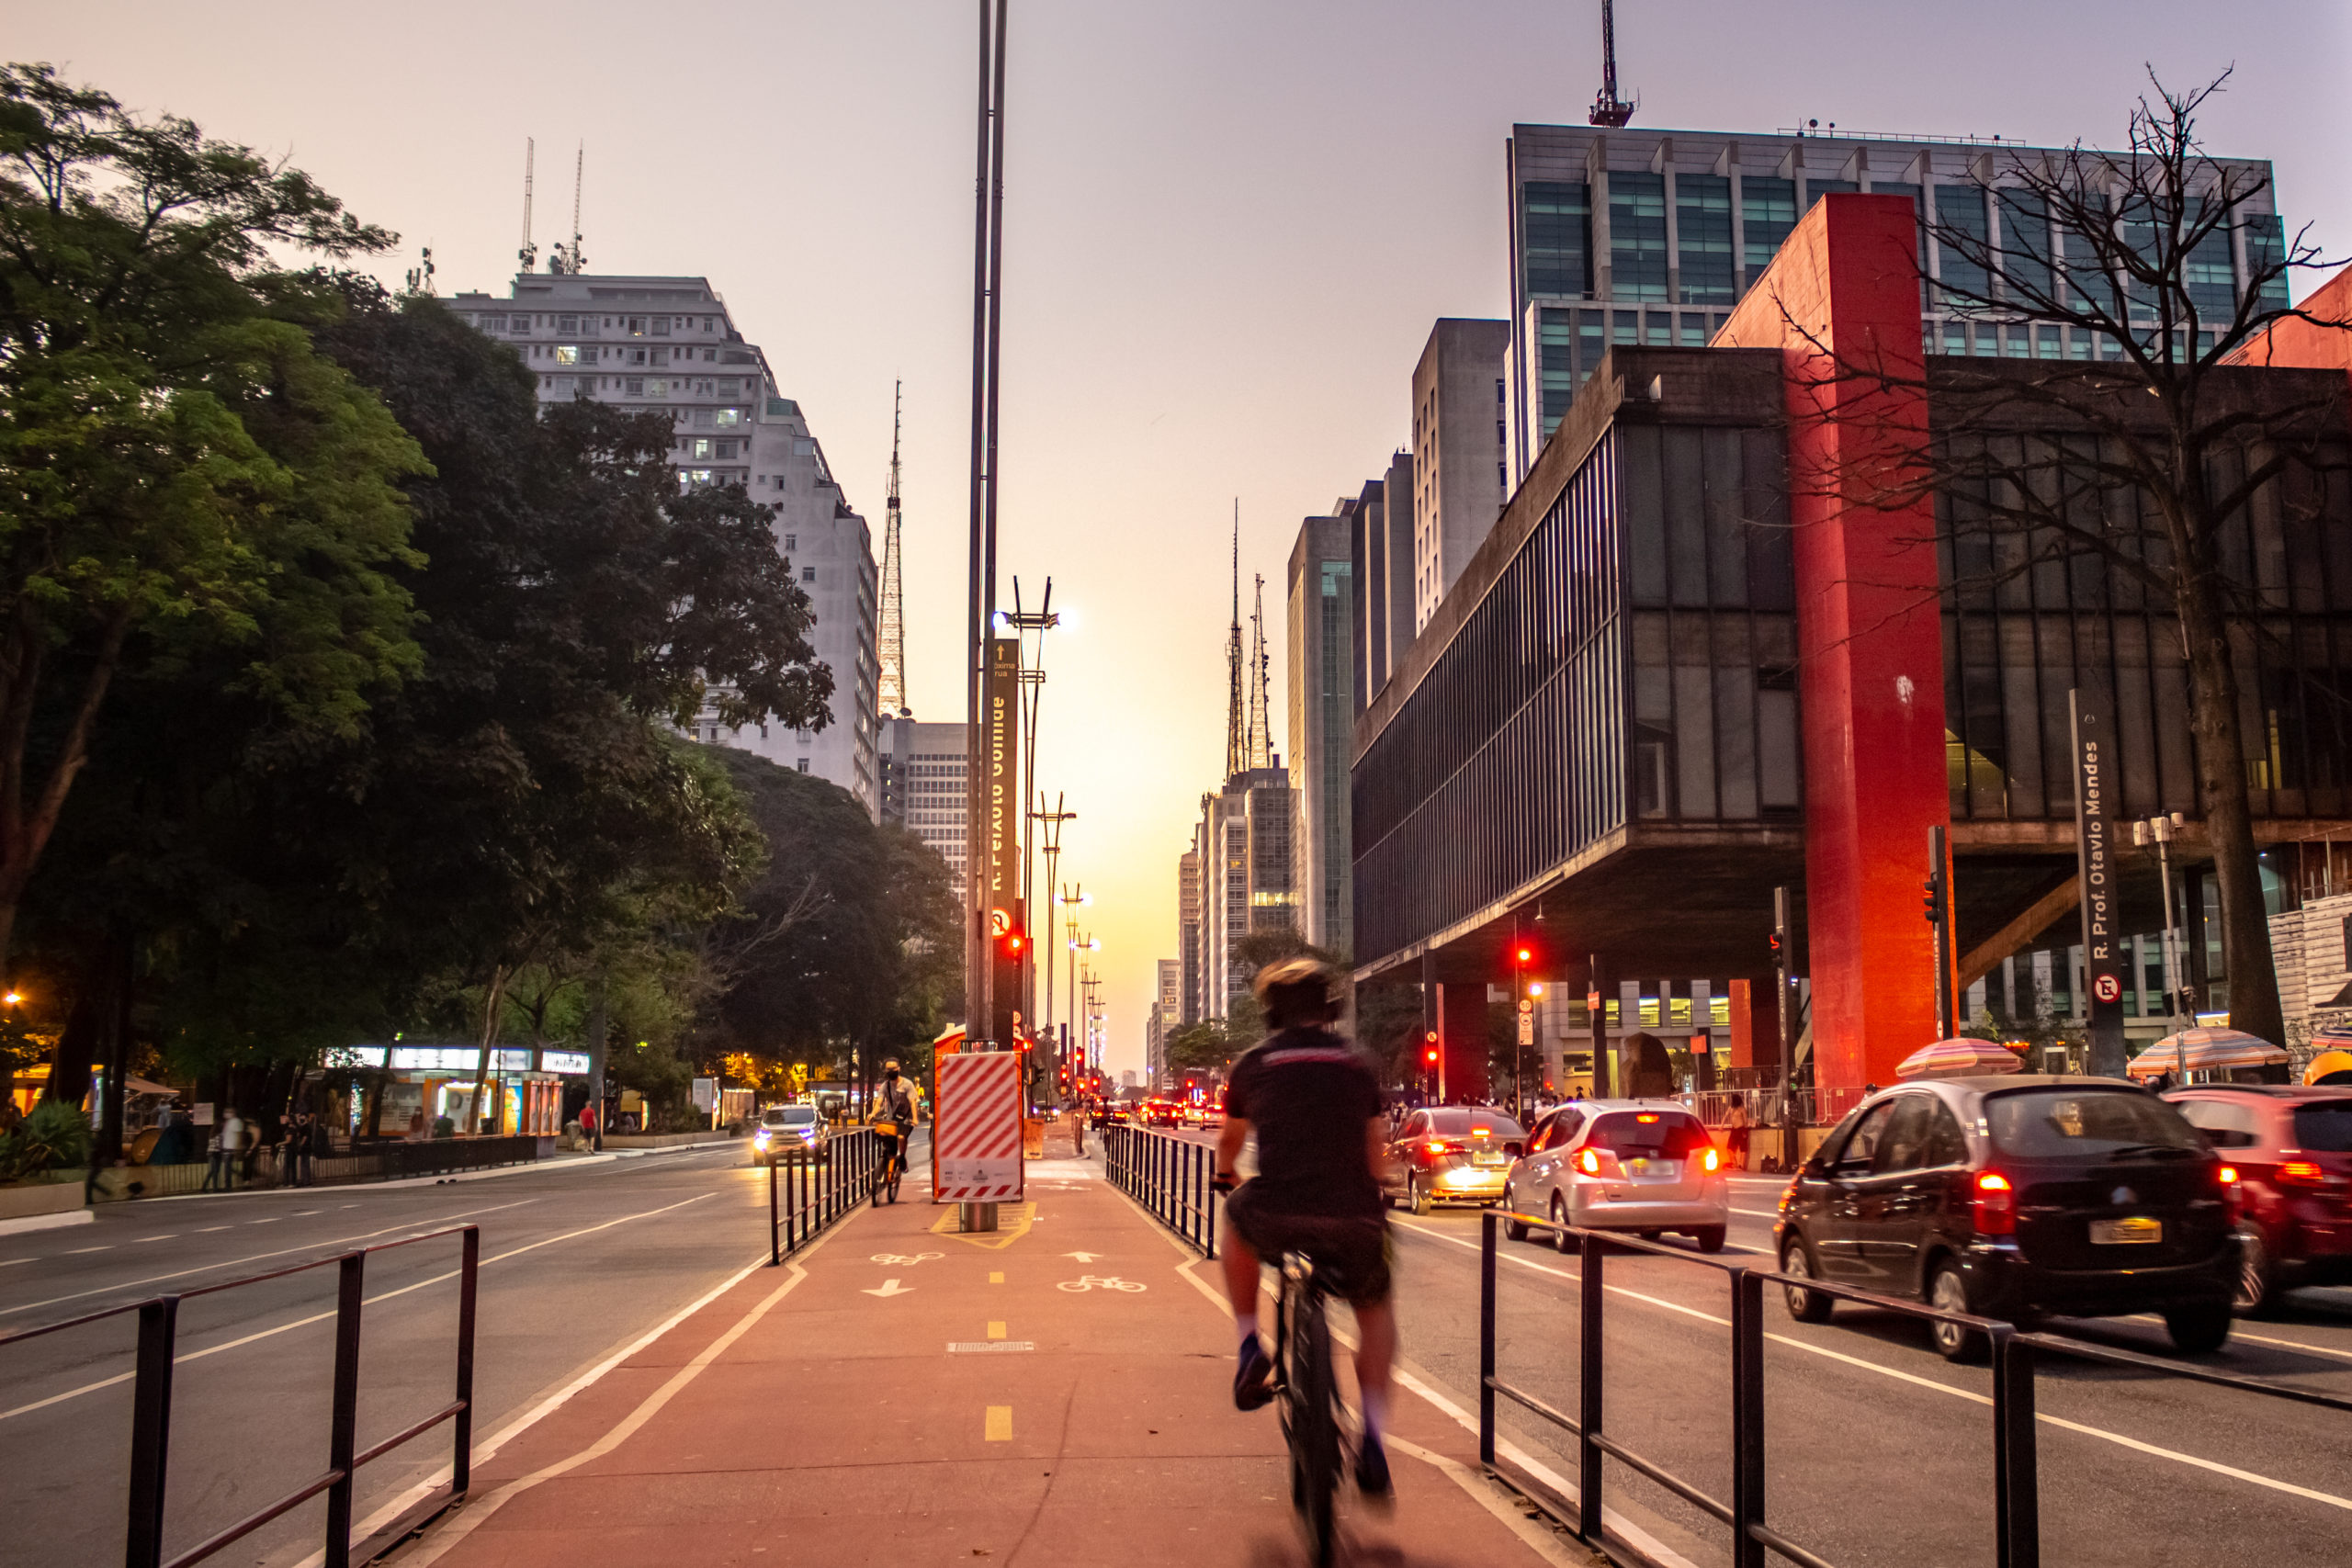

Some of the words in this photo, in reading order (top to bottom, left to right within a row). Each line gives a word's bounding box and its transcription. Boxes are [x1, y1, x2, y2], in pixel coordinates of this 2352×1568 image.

[2083, 741, 2102, 815] Mendes
[2087, 821, 2106, 886] Otavio
[2091, 890, 2108, 936] Prof.
[2094, 942, 2109, 960] R.
